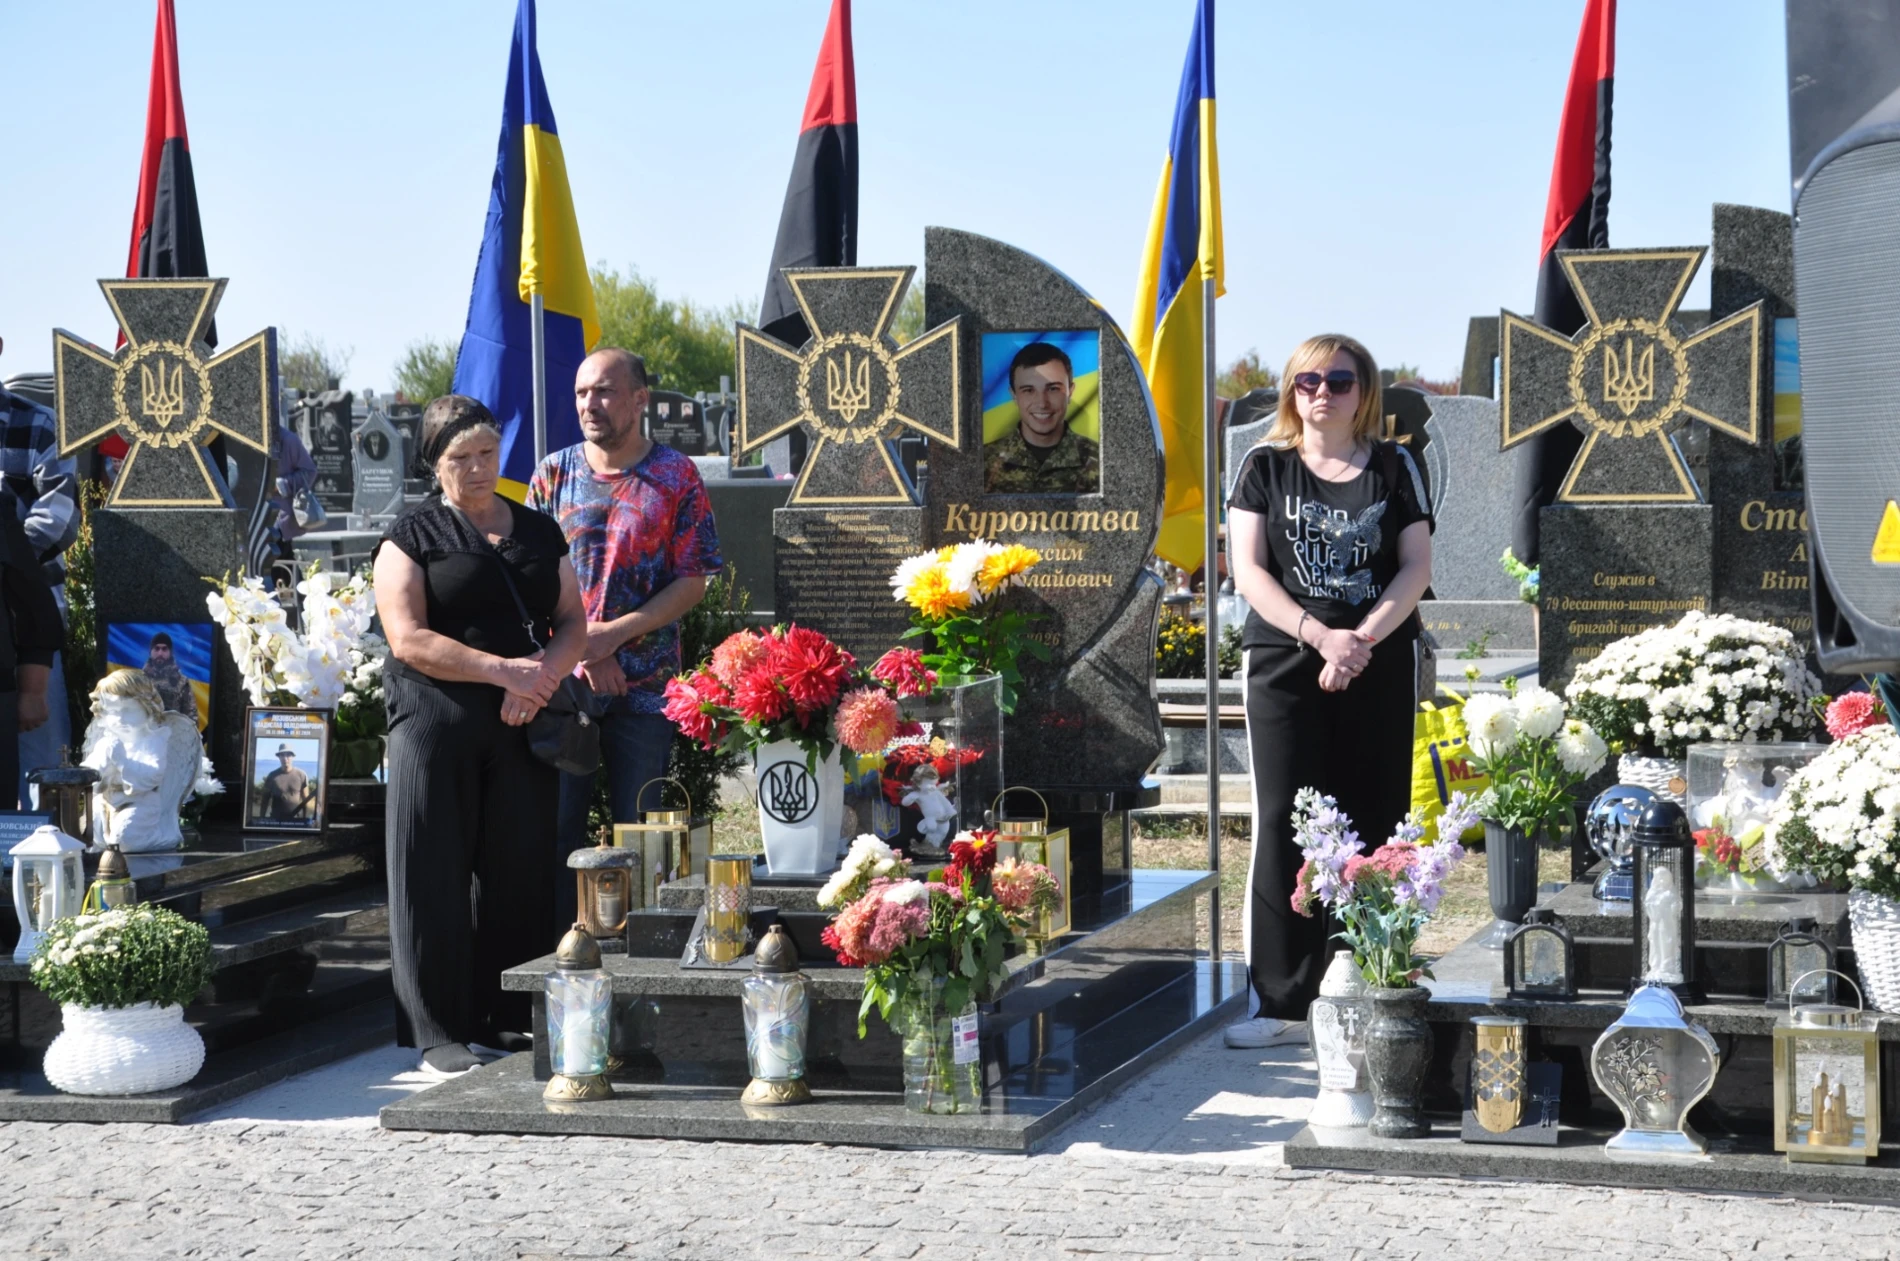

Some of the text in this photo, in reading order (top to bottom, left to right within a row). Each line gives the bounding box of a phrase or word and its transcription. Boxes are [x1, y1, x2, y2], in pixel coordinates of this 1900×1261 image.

[825, 512, 870, 523] Куропатва
[943, 503, 1141, 540] Куропатва
[806, 523, 890, 532] Максим Миколайович
[1036, 547, 1084, 562] ксим
[1789, 543, 1808, 563] А
[1593, 571, 1655, 590] Служив в
[1760, 570, 1808, 590] Віт
[1546, 596, 1705, 613] 79 десантно-штурмовій
[1569, 620, 1617, 637] бригаді
[1620, 623, 1635, 634] на
[1572, 643, 1603, 659] стрі
